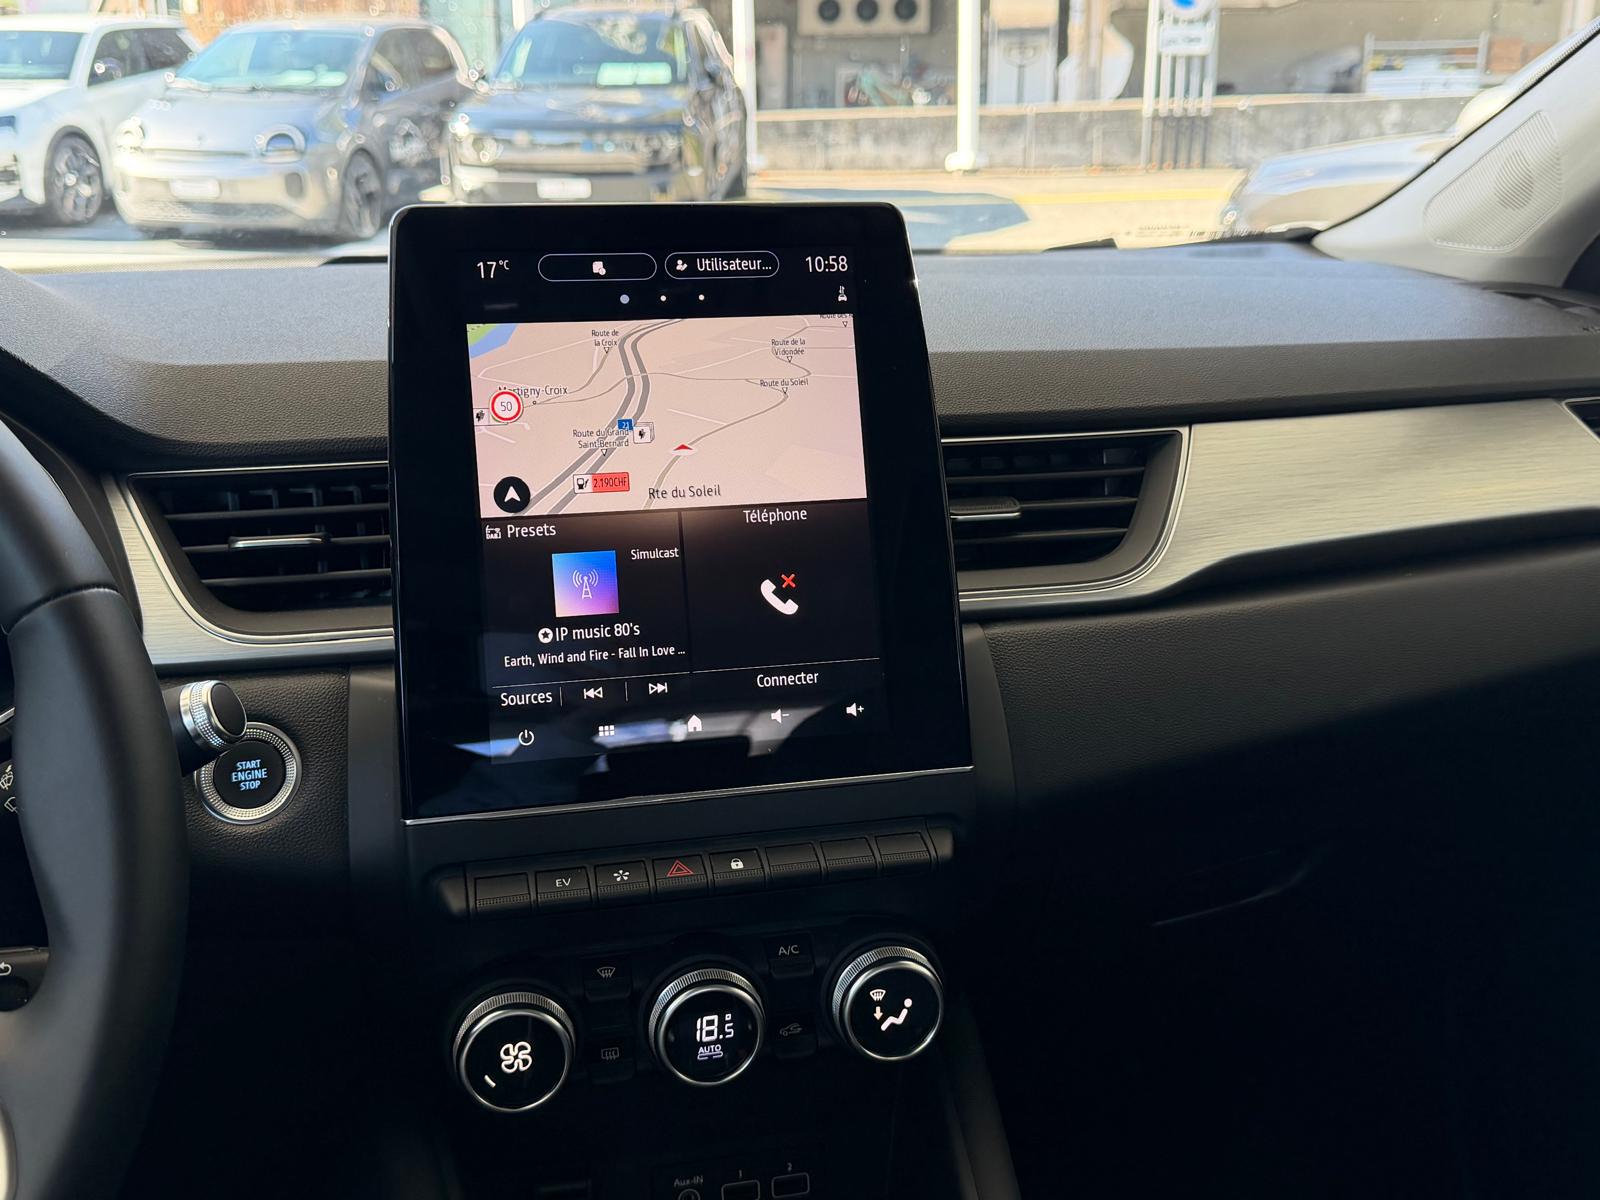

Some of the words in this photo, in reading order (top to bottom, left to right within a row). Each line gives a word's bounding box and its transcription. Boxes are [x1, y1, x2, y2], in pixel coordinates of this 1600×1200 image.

[696, 257, 772, 273] Utilisateur...
[805, 255, 849, 273] 10:58
[591, 329, 610, 337] Route
[594, 339, 601, 347] la
[771, 339, 791, 347] Route
[790, 338, 800, 346] de
[774, 348, 805, 357] Vidondée
[760, 379, 781, 387] Route
[781, 379, 791, 387] du
[791, 378, 809, 386] Soleil
[499, 384, 568, 398] tigny-Croix
[500, 401, 513, 411] 50
[572, 429, 594, 438] Route
[595, 428, 606, 437] du
[606, 427, 629, 436] Grand
[578, 438, 629, 449] Saint-Bernard
[593, 475, 628, 488] 2.190CHF
[648, 487, 668, 500] Rte
[670, 486, 687, 498] du
[688, 484, 722, 498] Soleil
[743, 508, 808, 524] Téléphone
[507, 523, 557, 538] Presets
[630, 547, 679, 561] Simulcast
[555, 627, 569, 642] IP
[572, 626, 611, 641] music
[614, 623, 640, 638] 80's
[504, 655, 536, 668] Earth,
[537, 652, 564, 666] Wind
[566, 650, 587, 664] and
[588, 650, 609, 663] Fire
[618, 647, 637, 660] Fall
[639, 647, 649, 658] In
[650, 645, 676, 658] Love
[756, 671, 819, 689] Connecter
[500, 689, 553, 707] Sources
[236, 759, 261, 771] START
[231, 768, 268, 782] ENGINE
[240, 780, 261, 791] STOP
[555, 877, 572, 888] EV
[778, 944, 800, 956] A/C
[698, 1044, 721, 1054] AUTO
